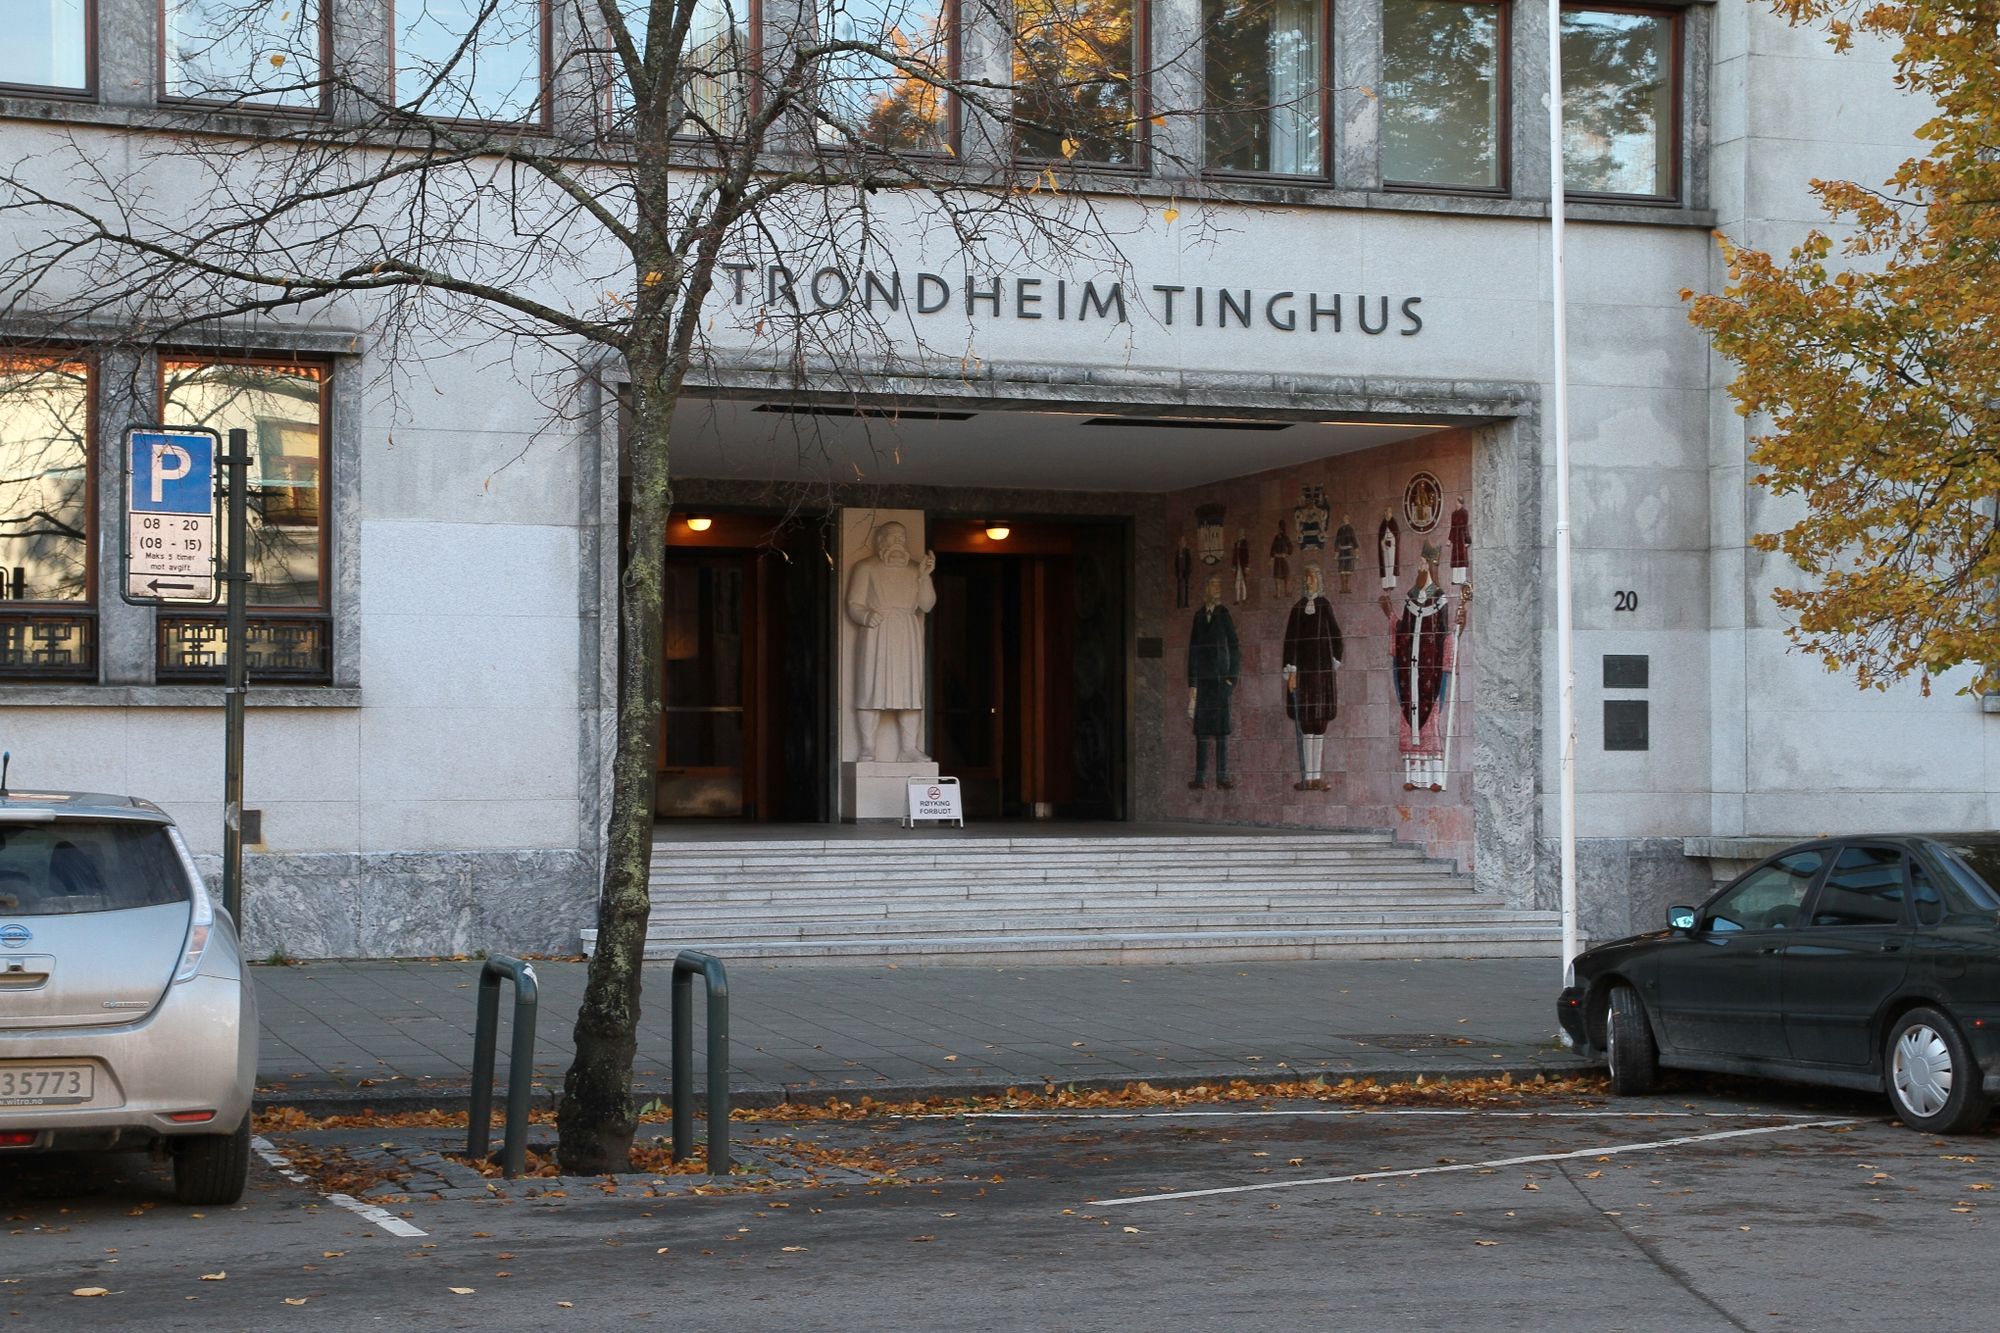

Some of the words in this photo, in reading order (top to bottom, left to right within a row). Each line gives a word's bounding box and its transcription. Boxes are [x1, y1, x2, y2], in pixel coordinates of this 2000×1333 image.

[721, 262, 1127, 323] TRONDHEIM
[1152, 284, 1423, 336] TINGHUS
[151, 444, 192, 503] P
[143, 518, 161, 530] 08
[182, 519, 199, 531] 20
[140, 536, 162, 549] (08
[184, 538, 202, 552] 15)
[145, 552, 165, 560] Maks
[176, 553, 196, 561] timer
[150, 563, 165, 571] mot
[168, 564, 191, 572] avgift
[1614, 590, 1638, 612] 20
[1, 1070, 82, 1096] 35773
